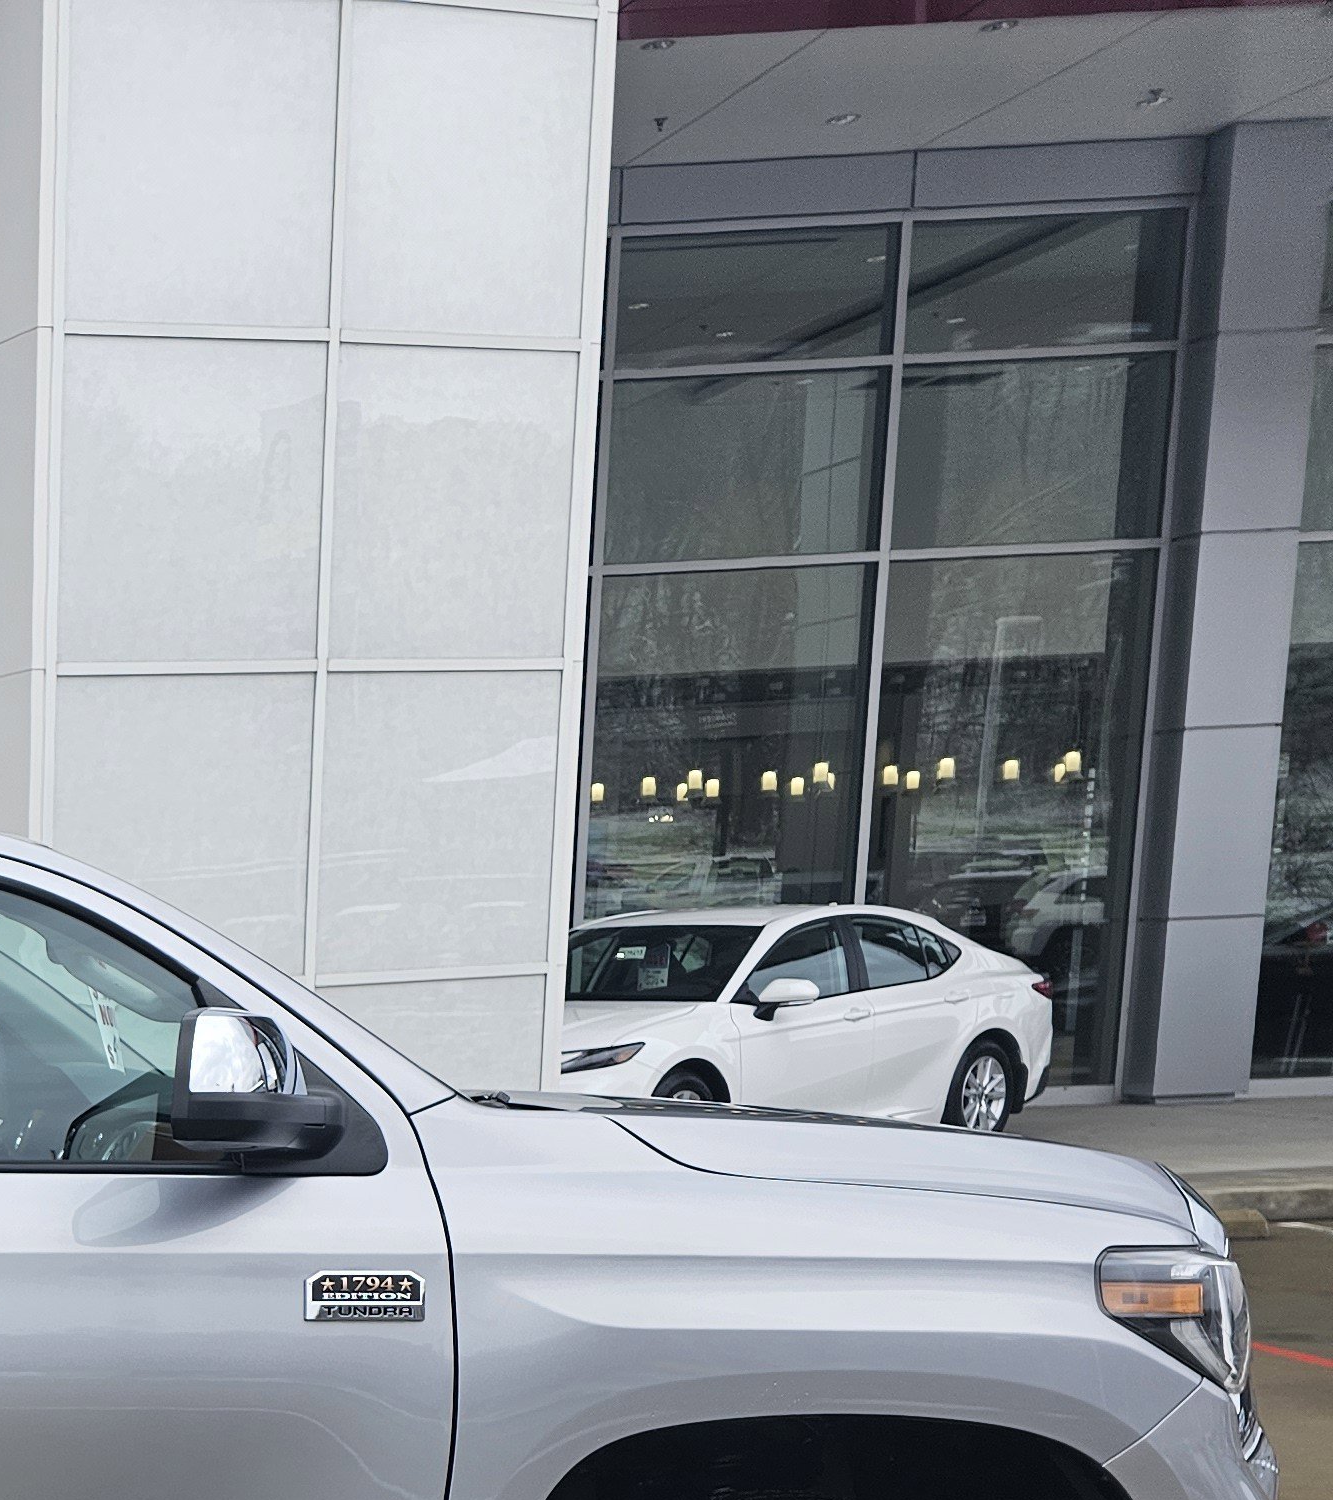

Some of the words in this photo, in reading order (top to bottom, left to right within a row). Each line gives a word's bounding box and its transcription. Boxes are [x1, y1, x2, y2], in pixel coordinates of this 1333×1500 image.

[340, 1276, 395, 1292] 1794
[322, 1292, 412, 1300] EDITION
[324, 1306, 413, 1317] TUNDRA
